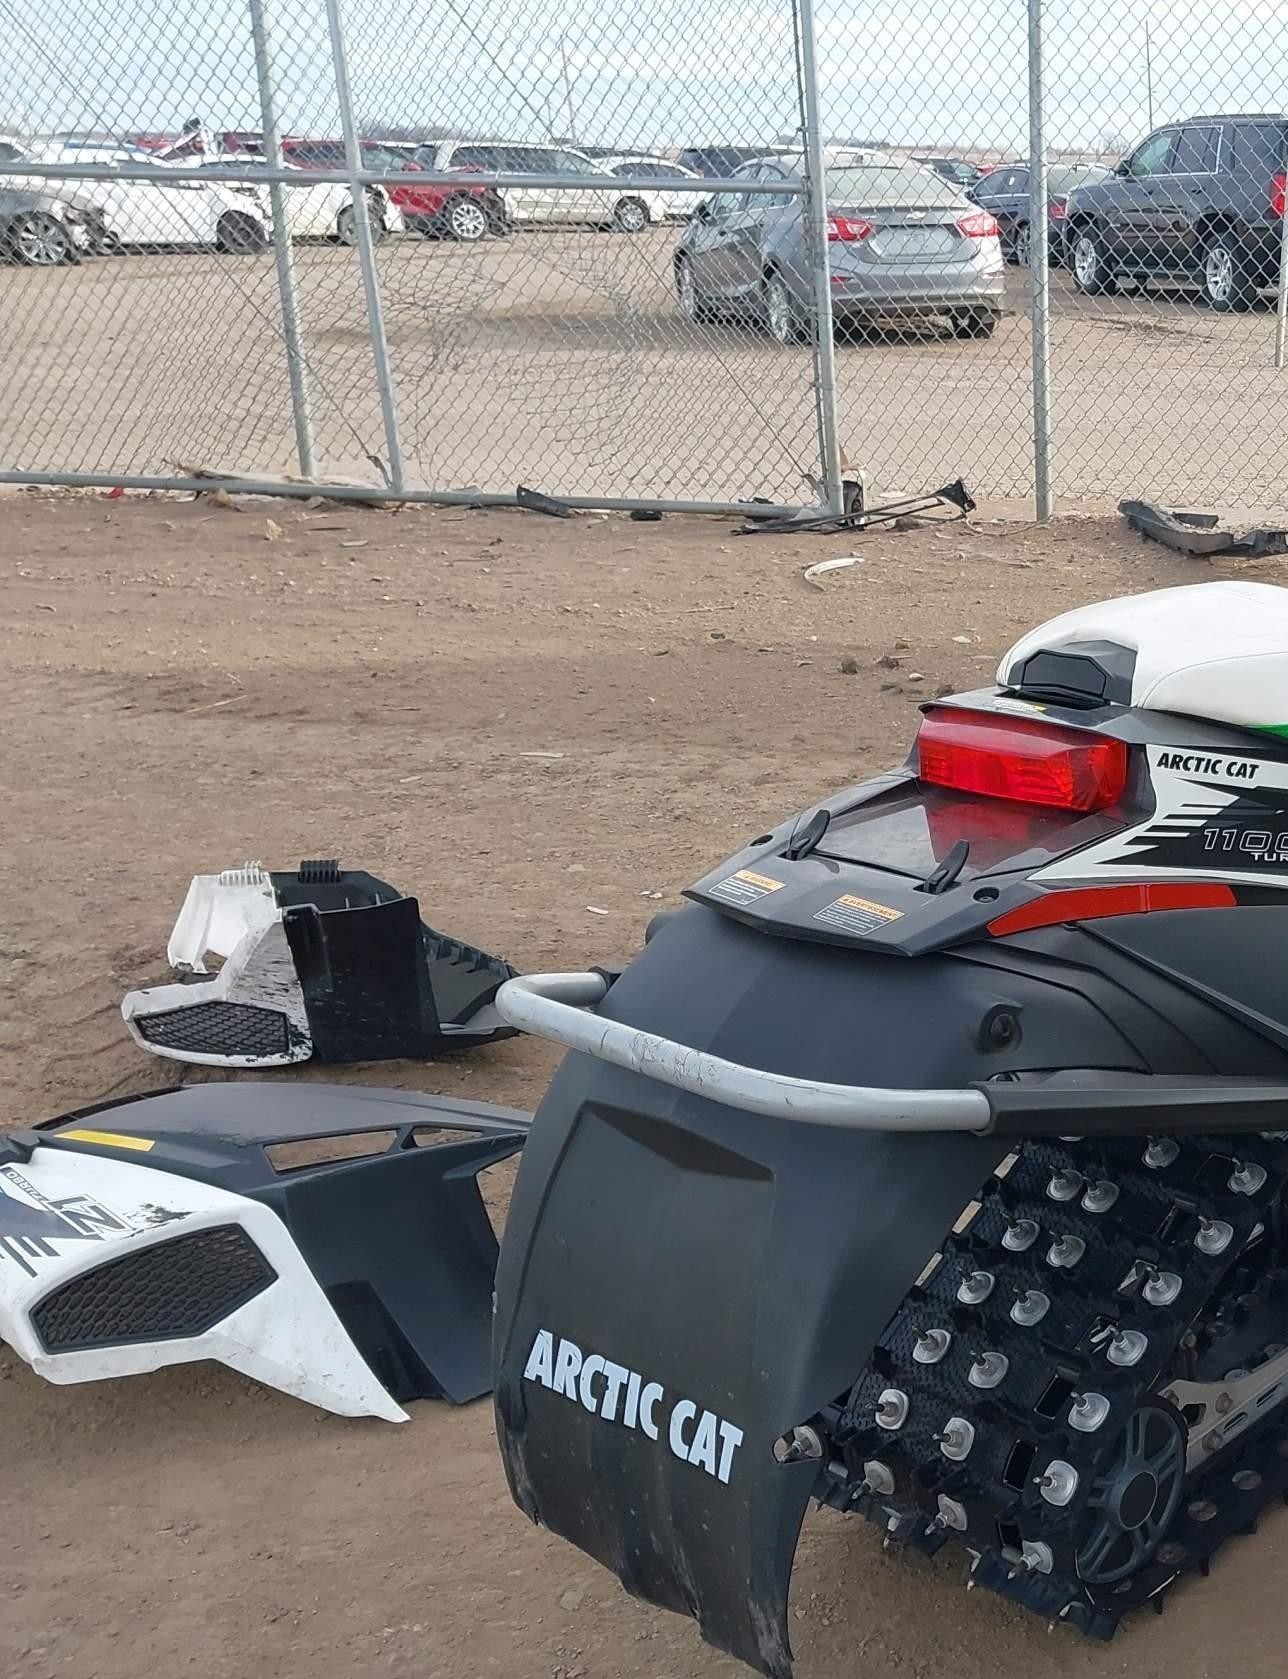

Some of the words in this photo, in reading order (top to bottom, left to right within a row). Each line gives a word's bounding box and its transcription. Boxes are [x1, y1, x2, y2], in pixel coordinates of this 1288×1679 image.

[1156, 752, 1223, 775] ARCTIC
[1225, 760, 1260, 779] CAT
[523, 1329, 664, 1441] ARCTIC
[669, 1400, 744, 1485] CAT
